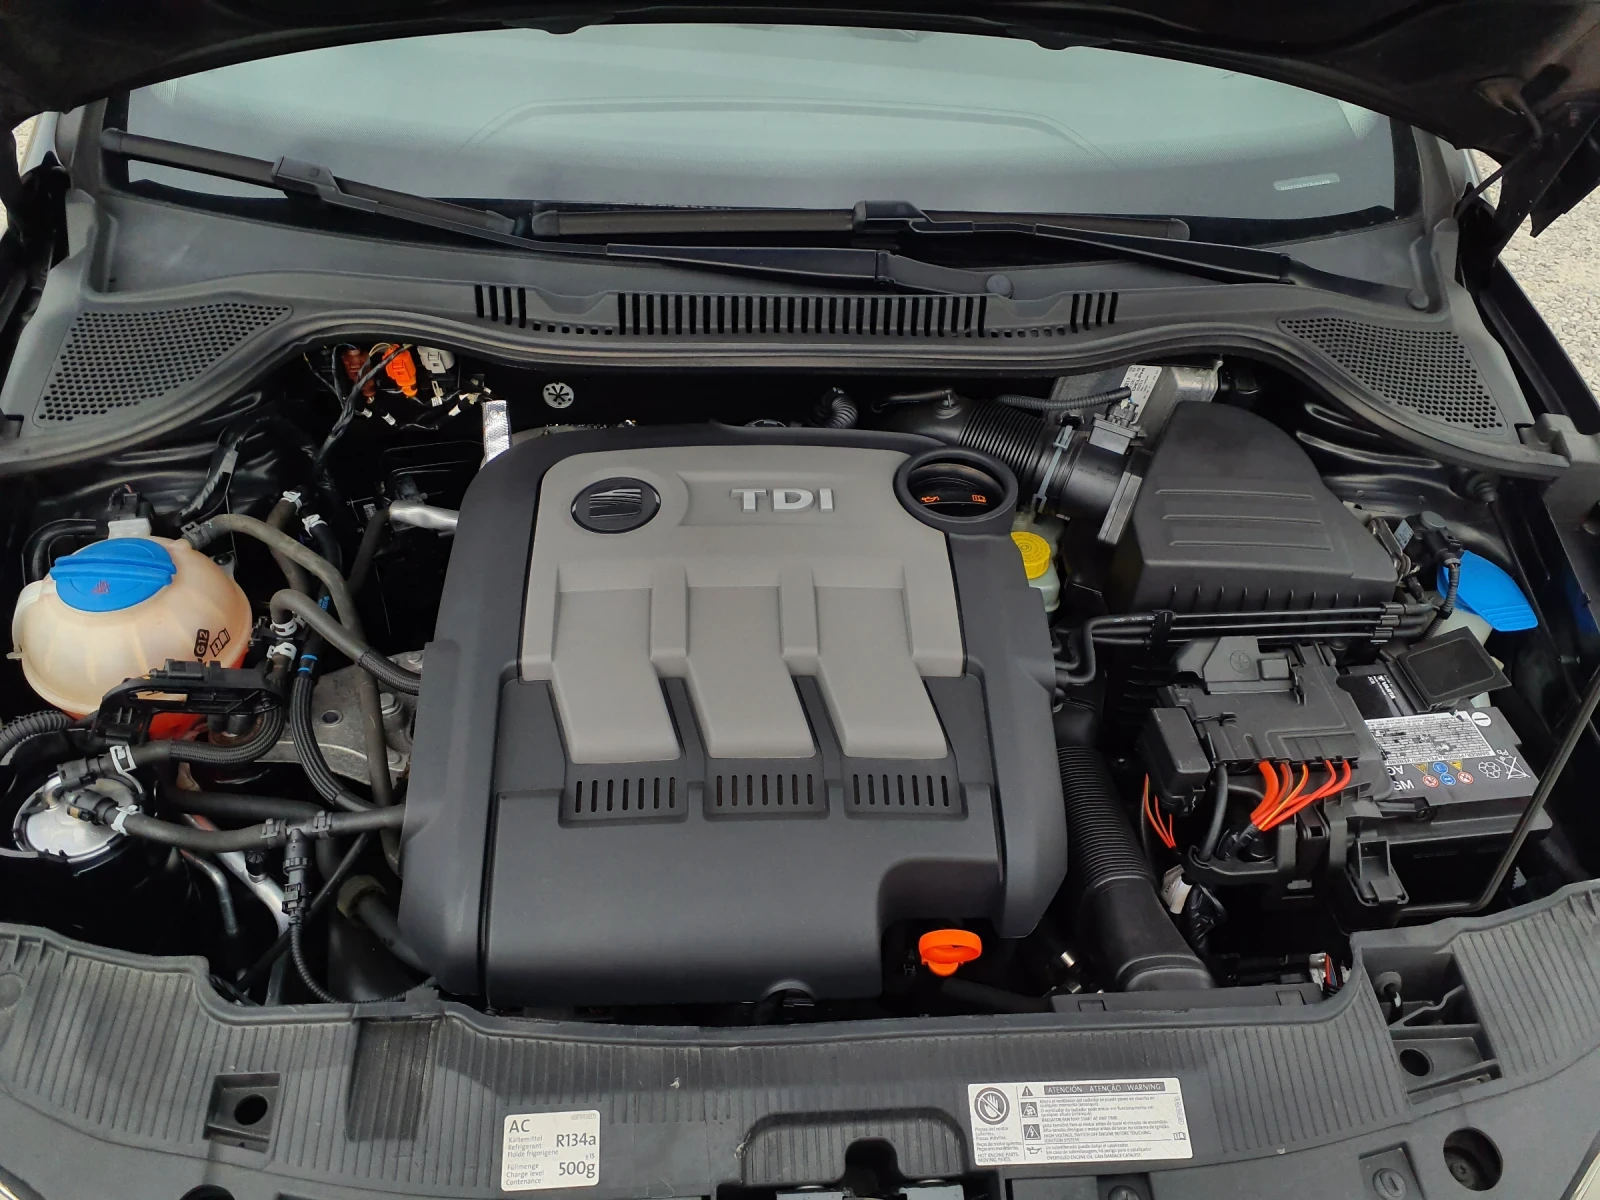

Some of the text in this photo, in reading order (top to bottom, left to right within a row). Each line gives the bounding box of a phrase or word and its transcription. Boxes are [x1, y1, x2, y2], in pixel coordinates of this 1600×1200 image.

[731, 488, 834, 512] TDI
[197, 631, 207, 654] G12
[1381, 681, 1396, 699] VARTA
[1048, 1083, 1160, 1094] ATENCIÓN ATENÇÃO WARNING
[509, 1119, 530, 1133] AC
[508, 1135, 542, 1143] Kältemittel
[556, 1133, 596, 1148] R134a
[526, 1150, 558, 1158] frigorigène
[559, 1161, 596, 1178] 500g
[506, 1178, 542, 1186] Contenance
